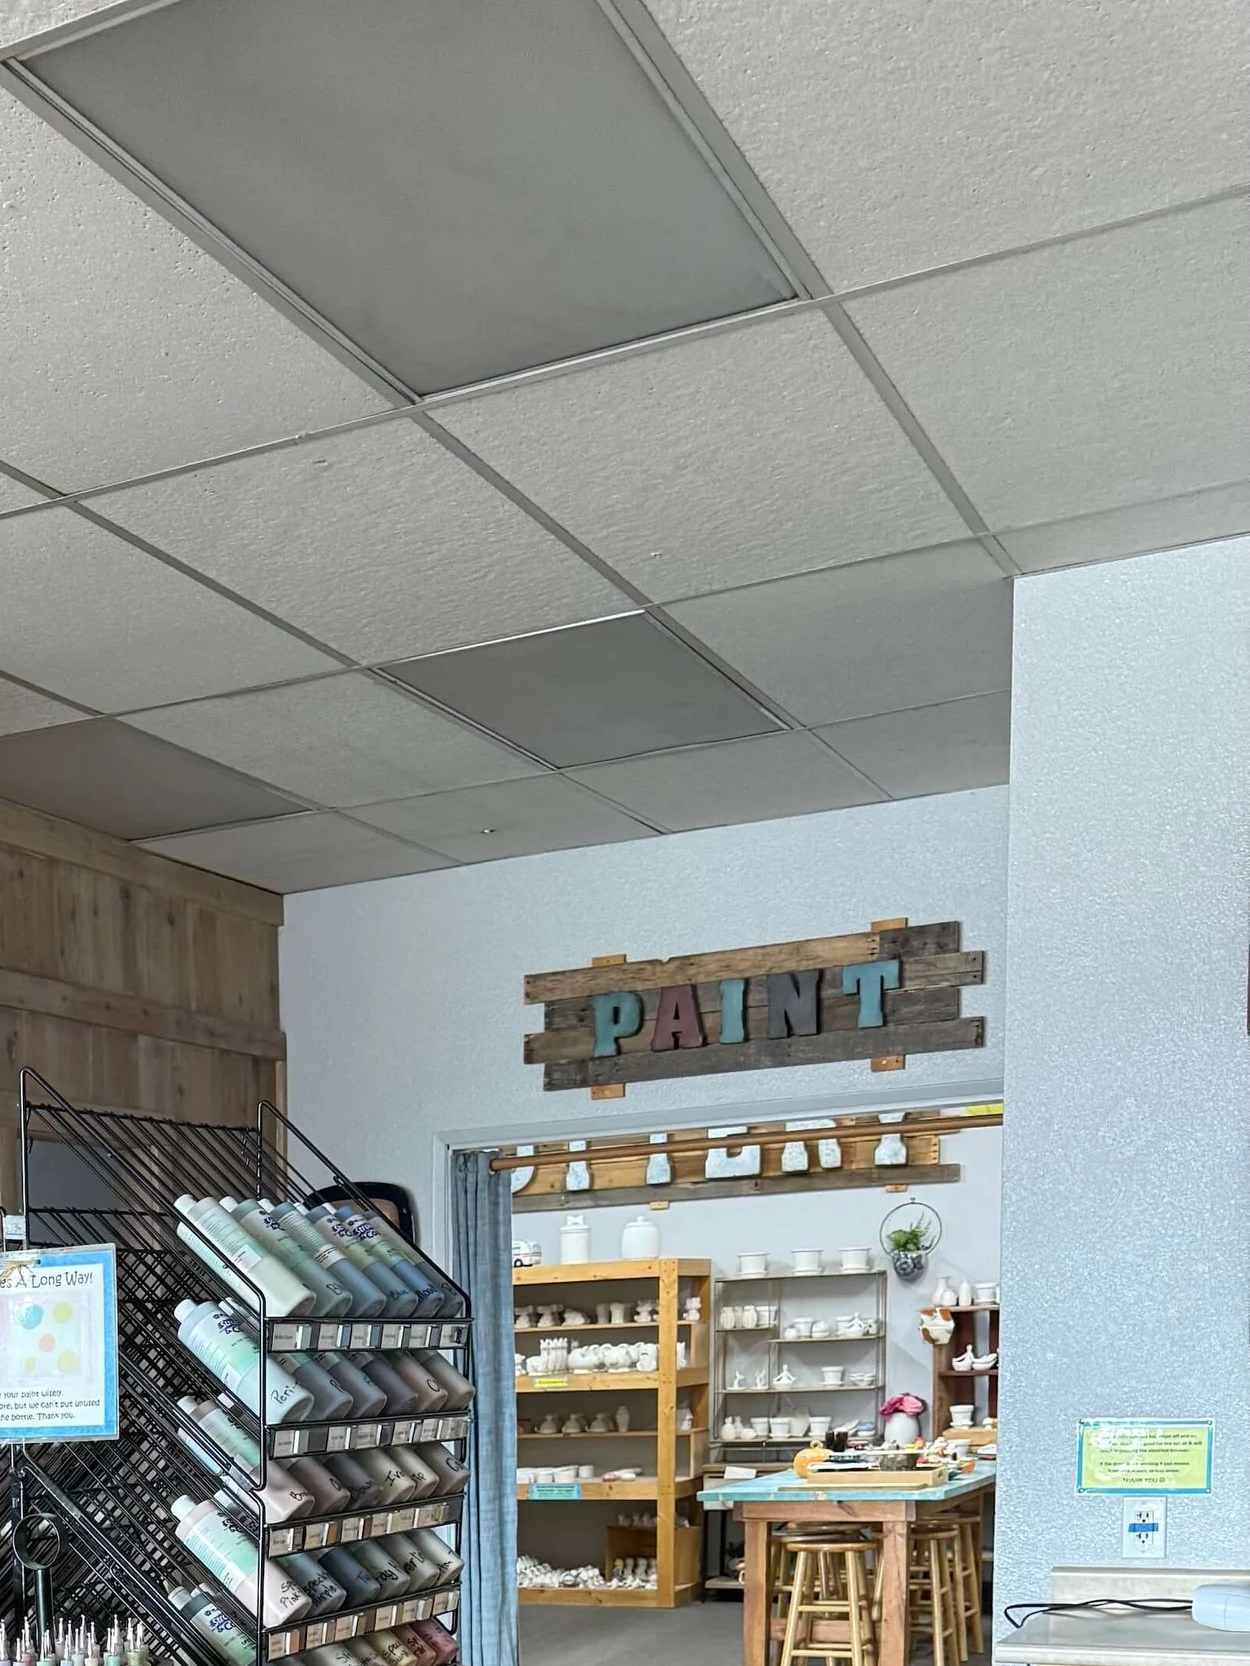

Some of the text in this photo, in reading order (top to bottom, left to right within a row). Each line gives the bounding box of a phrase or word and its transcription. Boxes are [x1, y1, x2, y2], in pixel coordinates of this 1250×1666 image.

[591, 958, 901, 1058] PAINT
[15, 1276, 27, 1289] A
[31, 1273, 62, 1289] Long
[65, 1270, 94, 1286] Way!
[3, 1391, 19, 1401] your
[21, 1390, 39, 1399] paint
[41, 1388, 64, 1398] wisely.
[14, 1401, 27, 1410] but
[40, 1400, 59, 1409] can't
[60, 1400, 74, 1409] put
[74, 1398, 100, 1407] unused
[11, 1411, 35, 1421] bottle.
[36, 1411, 60, 1421] Thank
[60, 1411, 76, 1420] you.
